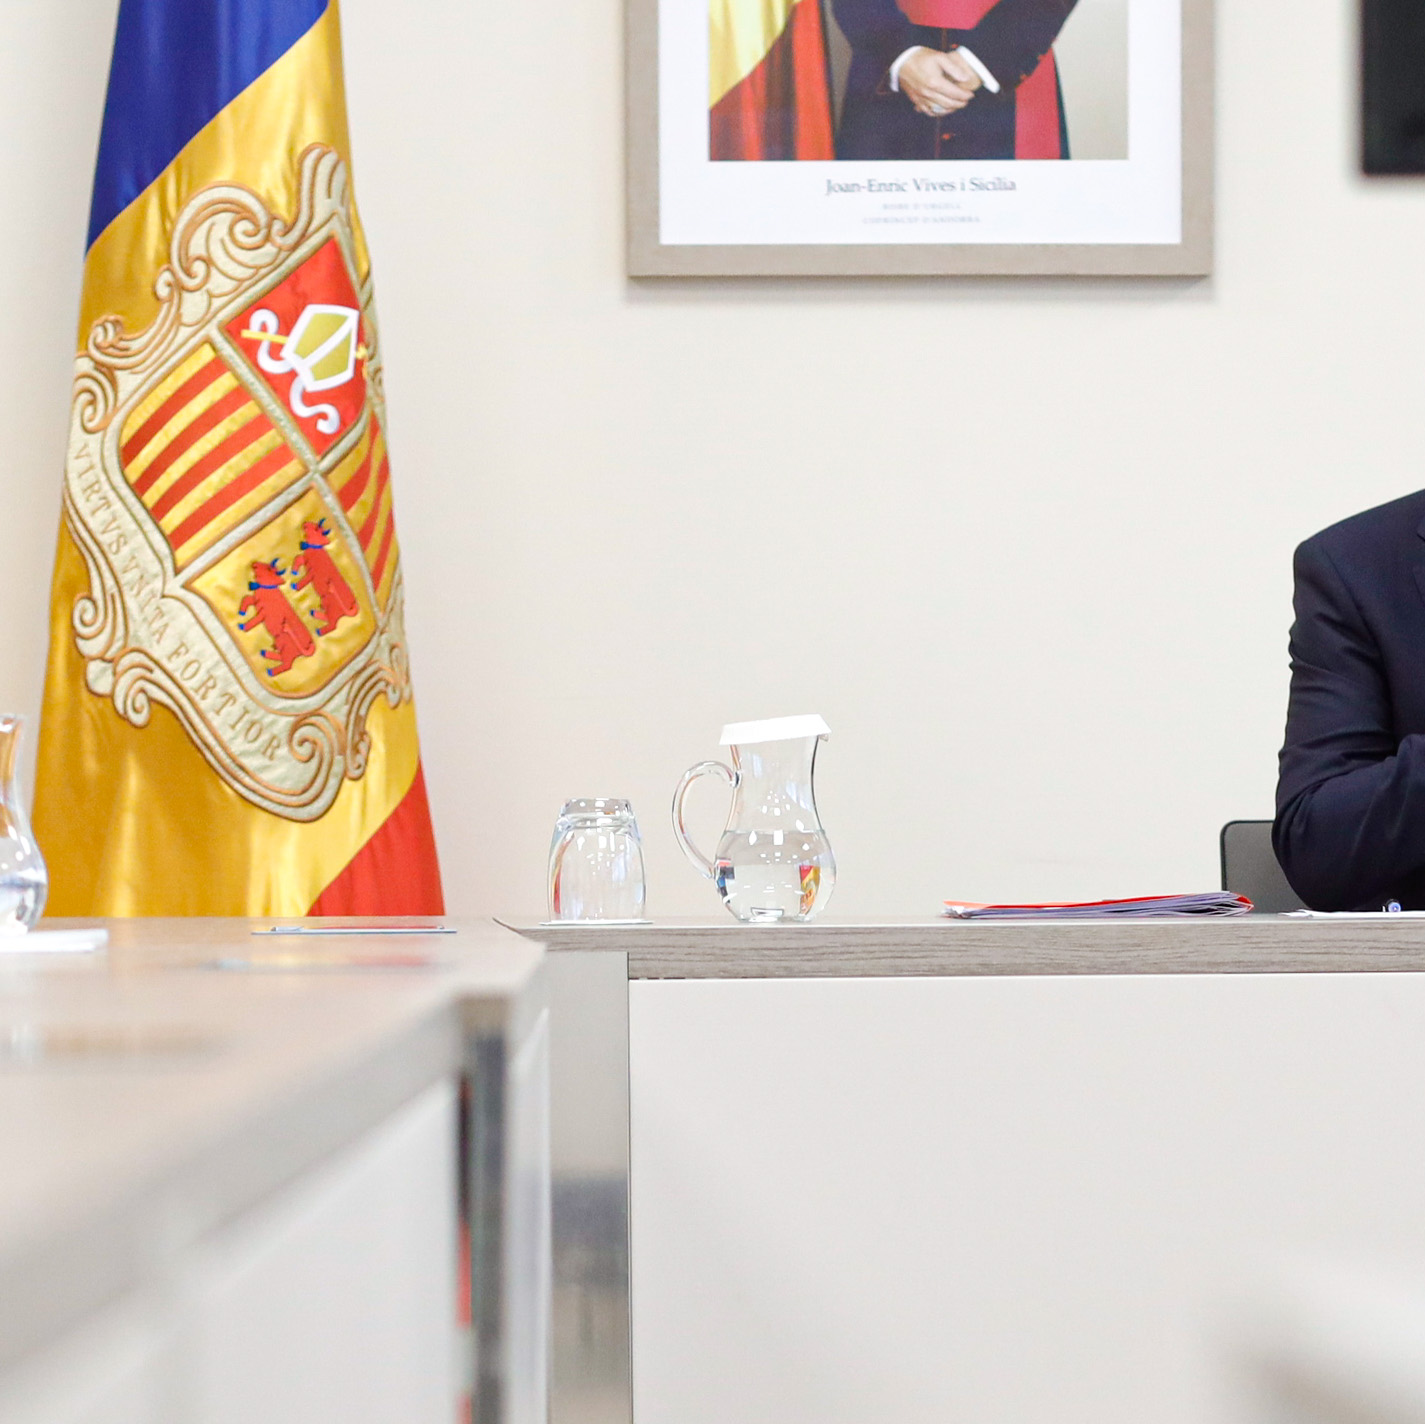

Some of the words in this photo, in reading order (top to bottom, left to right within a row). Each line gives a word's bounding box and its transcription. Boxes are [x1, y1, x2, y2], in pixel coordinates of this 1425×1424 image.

[825, 178, 908, 196] Joan-Enric
[912, 177, 956, 192] Vives
[167, 642, 282, 761] FORTIOR
